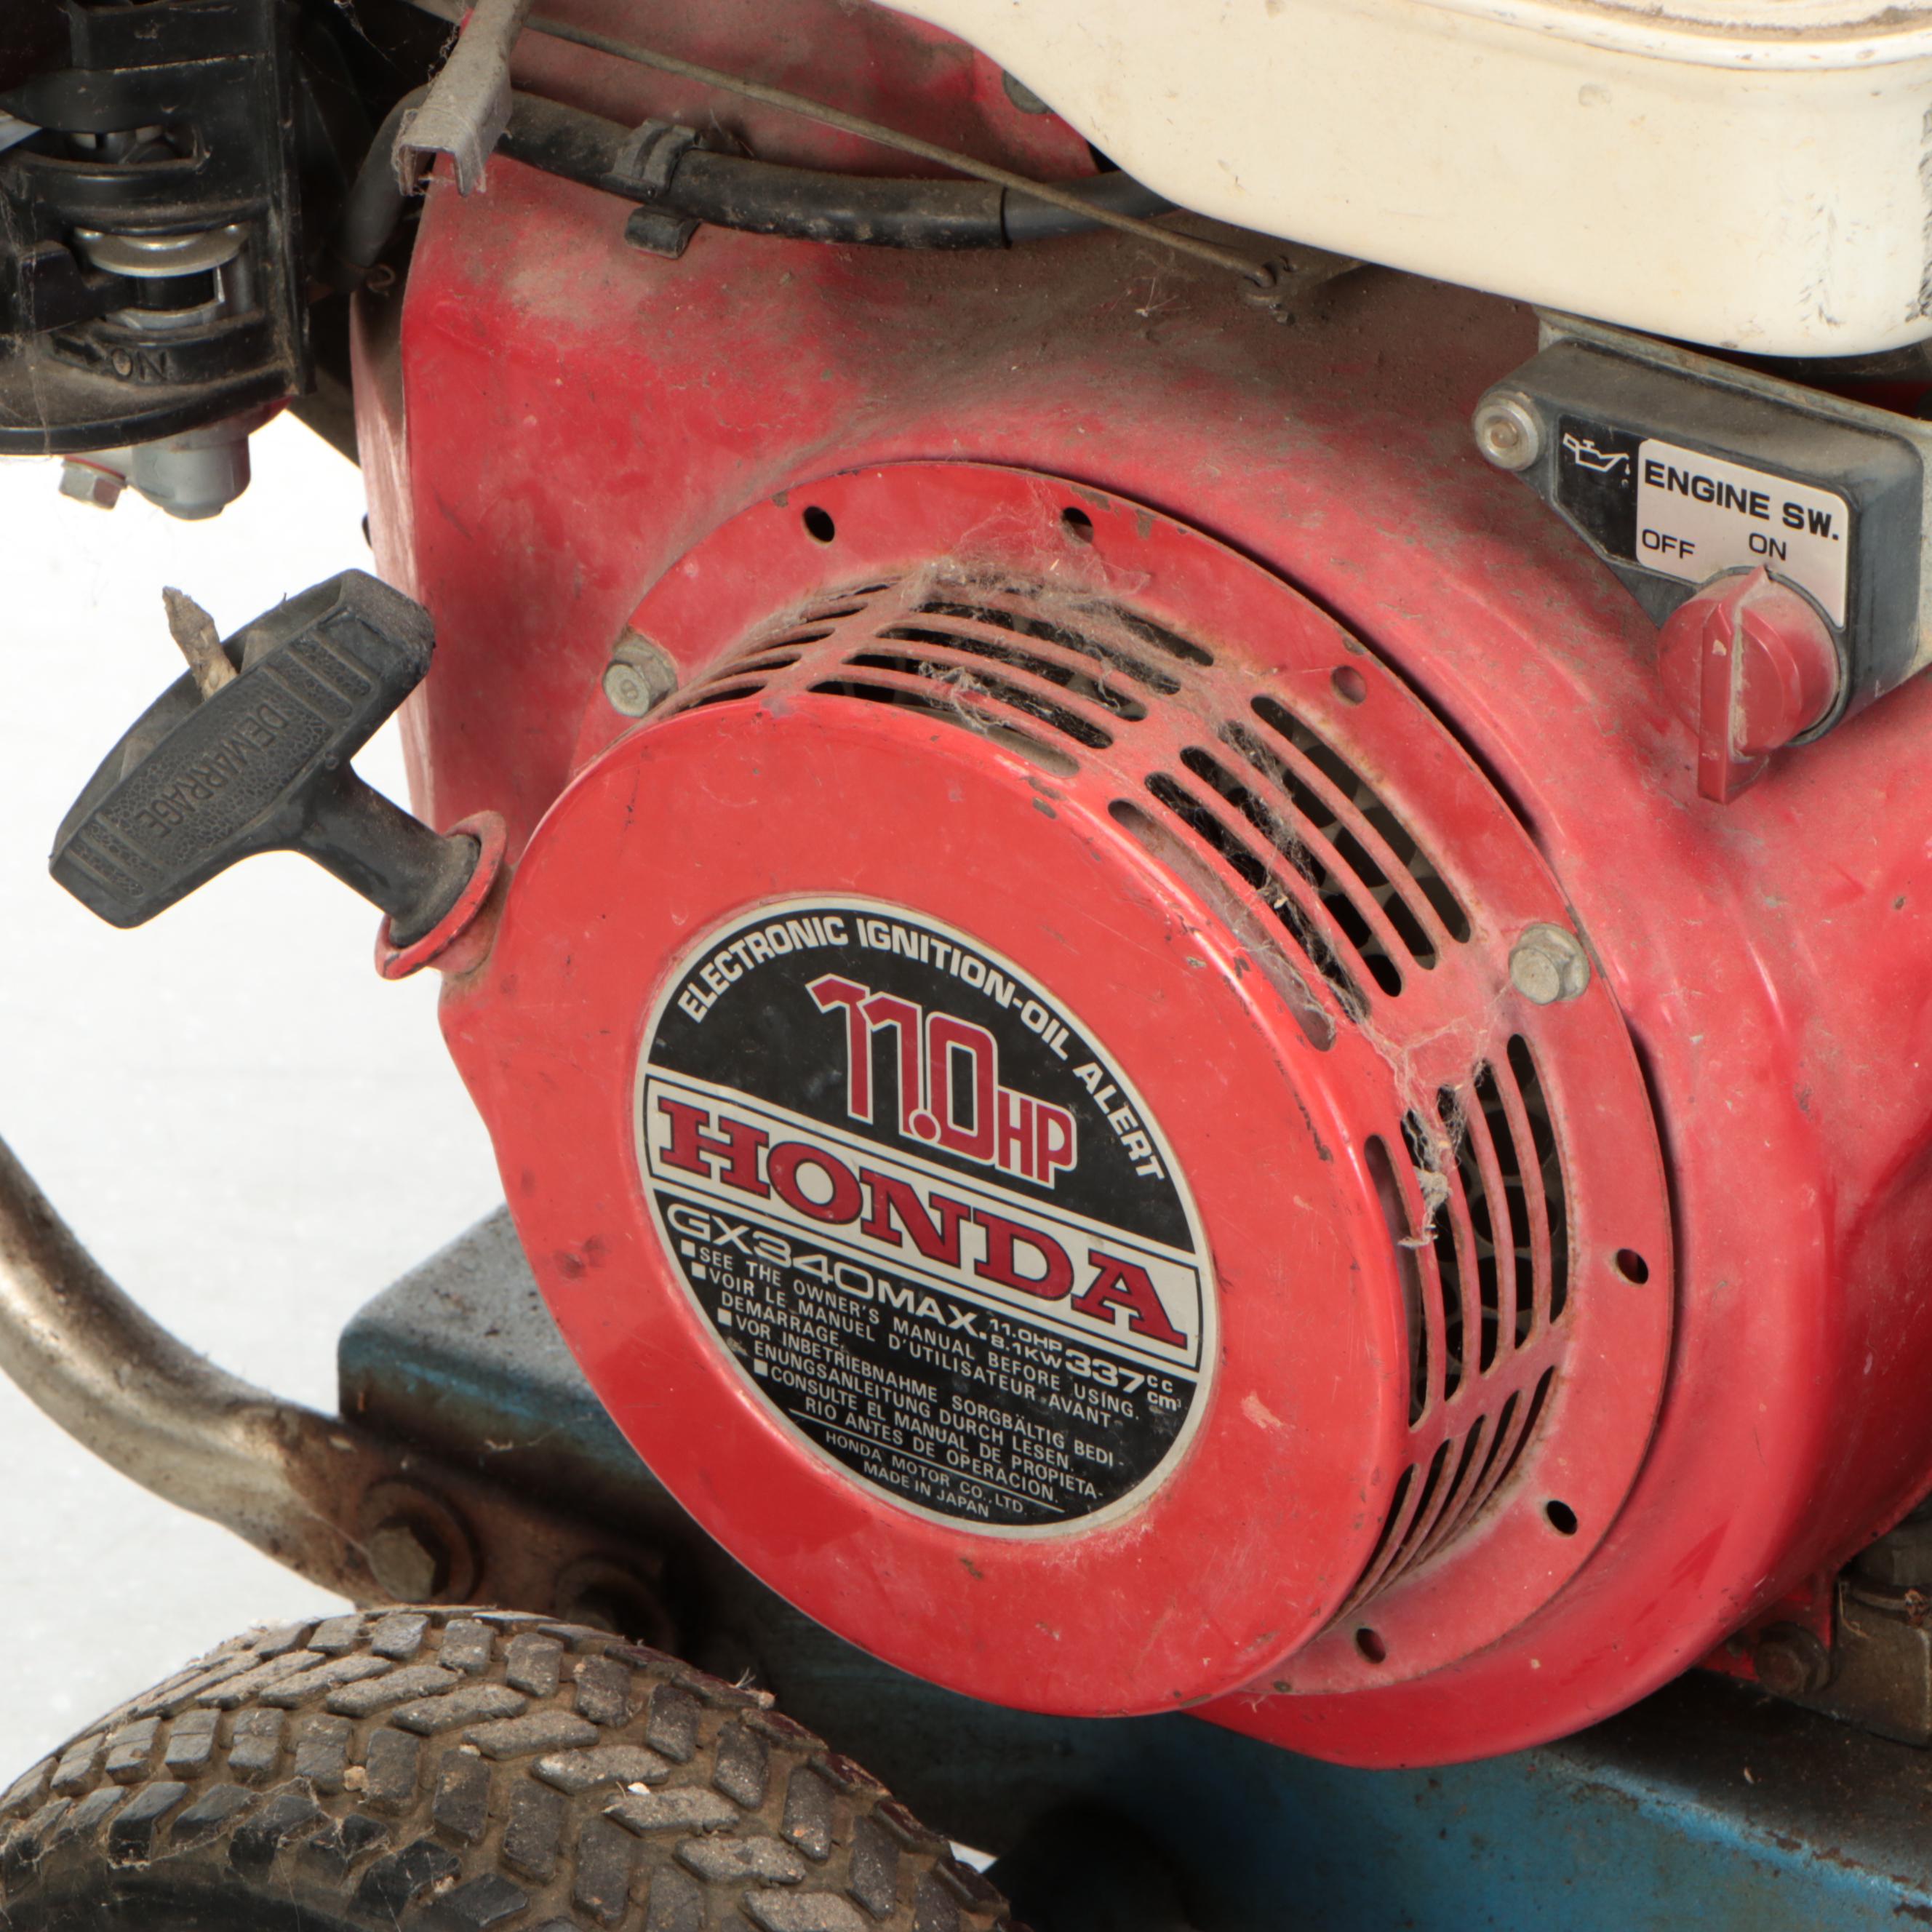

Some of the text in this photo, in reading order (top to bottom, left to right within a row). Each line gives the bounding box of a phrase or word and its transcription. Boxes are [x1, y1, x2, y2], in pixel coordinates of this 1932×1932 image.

[111, 347, 167, 379] ON
[1641, 528, 1787, 561] OFF ON
[1645, 458, 1840, 540] ENGINE SW.
[135, 703, 288, 839] DEMARRAGE
[677, 916, 849, 1023] ELECTRONIC
[1072, 1062, 1165, 1180] ALERT
[658, 1095, 1188, 1351] HONDA
[700, 1246, 1139, 1421] SEE THE OWNER'S MANUAL BEFORE USING.
[708, 1268, 1113, 1429] VOIR LE MANUEL D'UTILISATEUR AVANT
[735, 1314, 771, 1341] VOR
[783, 1331, 938, 1402] INBETRIEBNAHME
[951, 1395, 1065, 1450] SORGBÄLTIG
[989, 1318, 1063, 1352] 11.0HP
[1065, 1348, 1148, 1393] 337
[754, 1341, 1074, 1472] ENUNGSANLEITUNG DURCH LESEN.
[771, 1365, 1103, 1499] CONSULTE EL MANUAL DE PROPIETA-
[805, 1397, 1058, 1504] RIO ANTES DE OPERACION.
[826, 1430, 882, 1463] HONDA
[893, 1455, 950, 1488] MOTOR
[864, 1461, 989, 1518] MADE IN JAPAN
